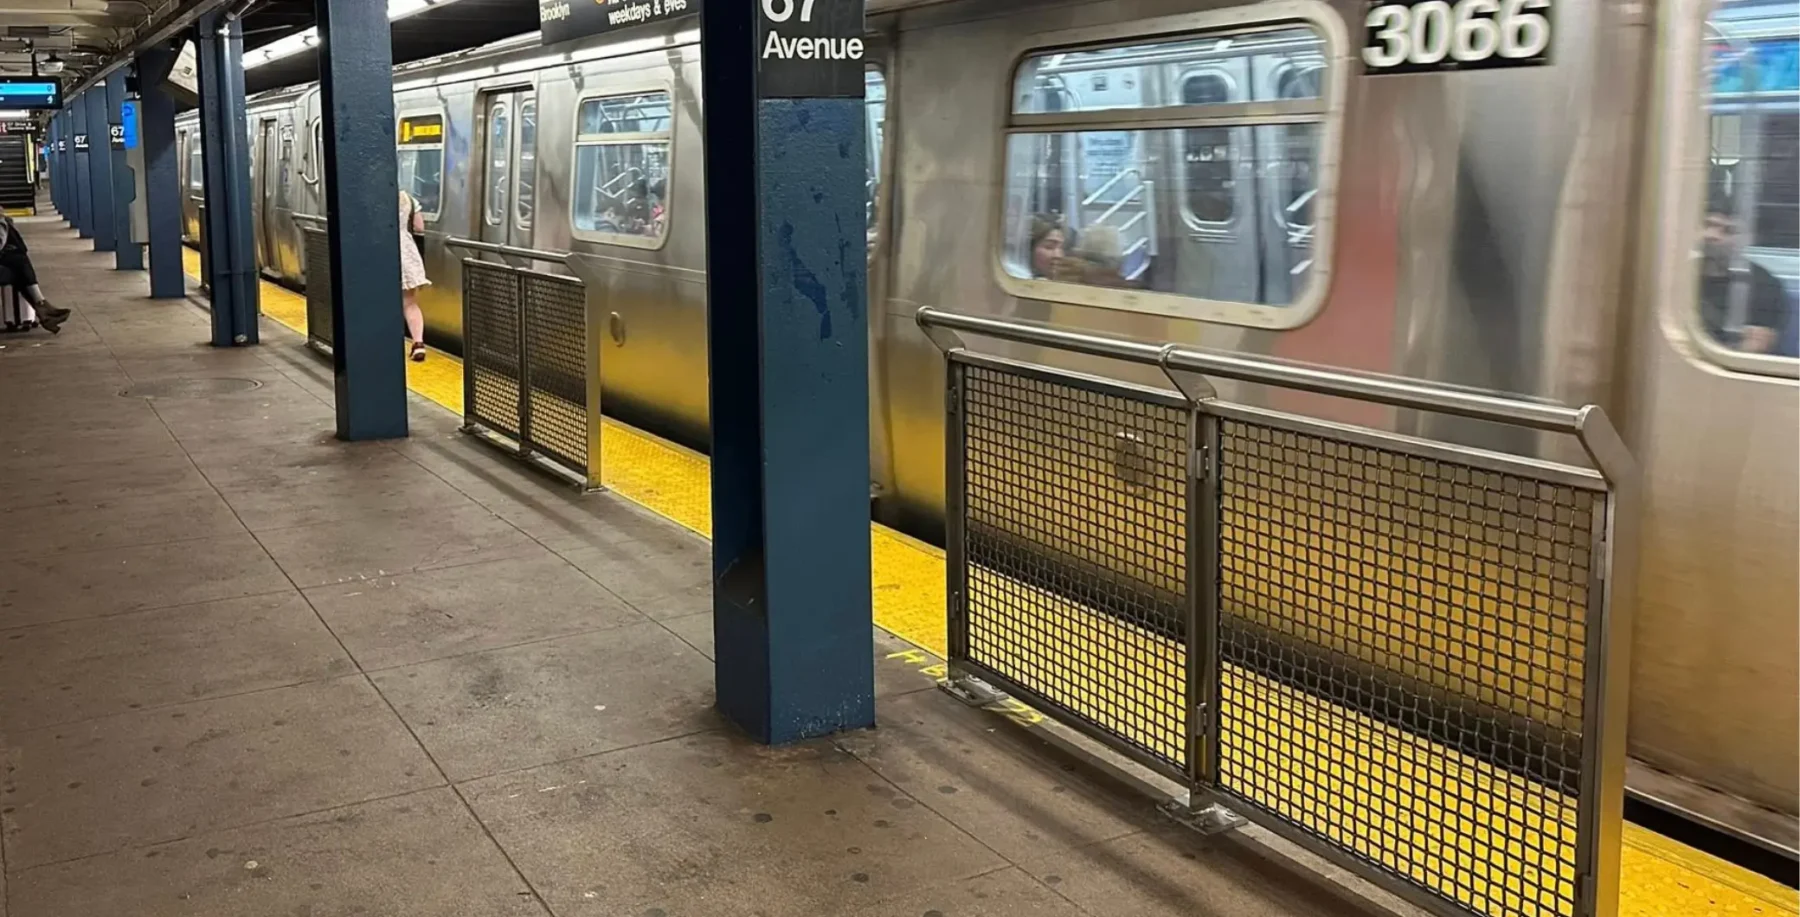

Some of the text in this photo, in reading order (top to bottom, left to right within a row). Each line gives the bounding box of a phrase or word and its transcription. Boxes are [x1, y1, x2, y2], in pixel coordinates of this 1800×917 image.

[540, 1, 570, 22] Brooklyn
[608, 2, 651, 25] weekdays
[762, 30, 864, 59] Avenue
[1361, 0, 1550, 67] 3066
[110, 125, 125, 136] 67
